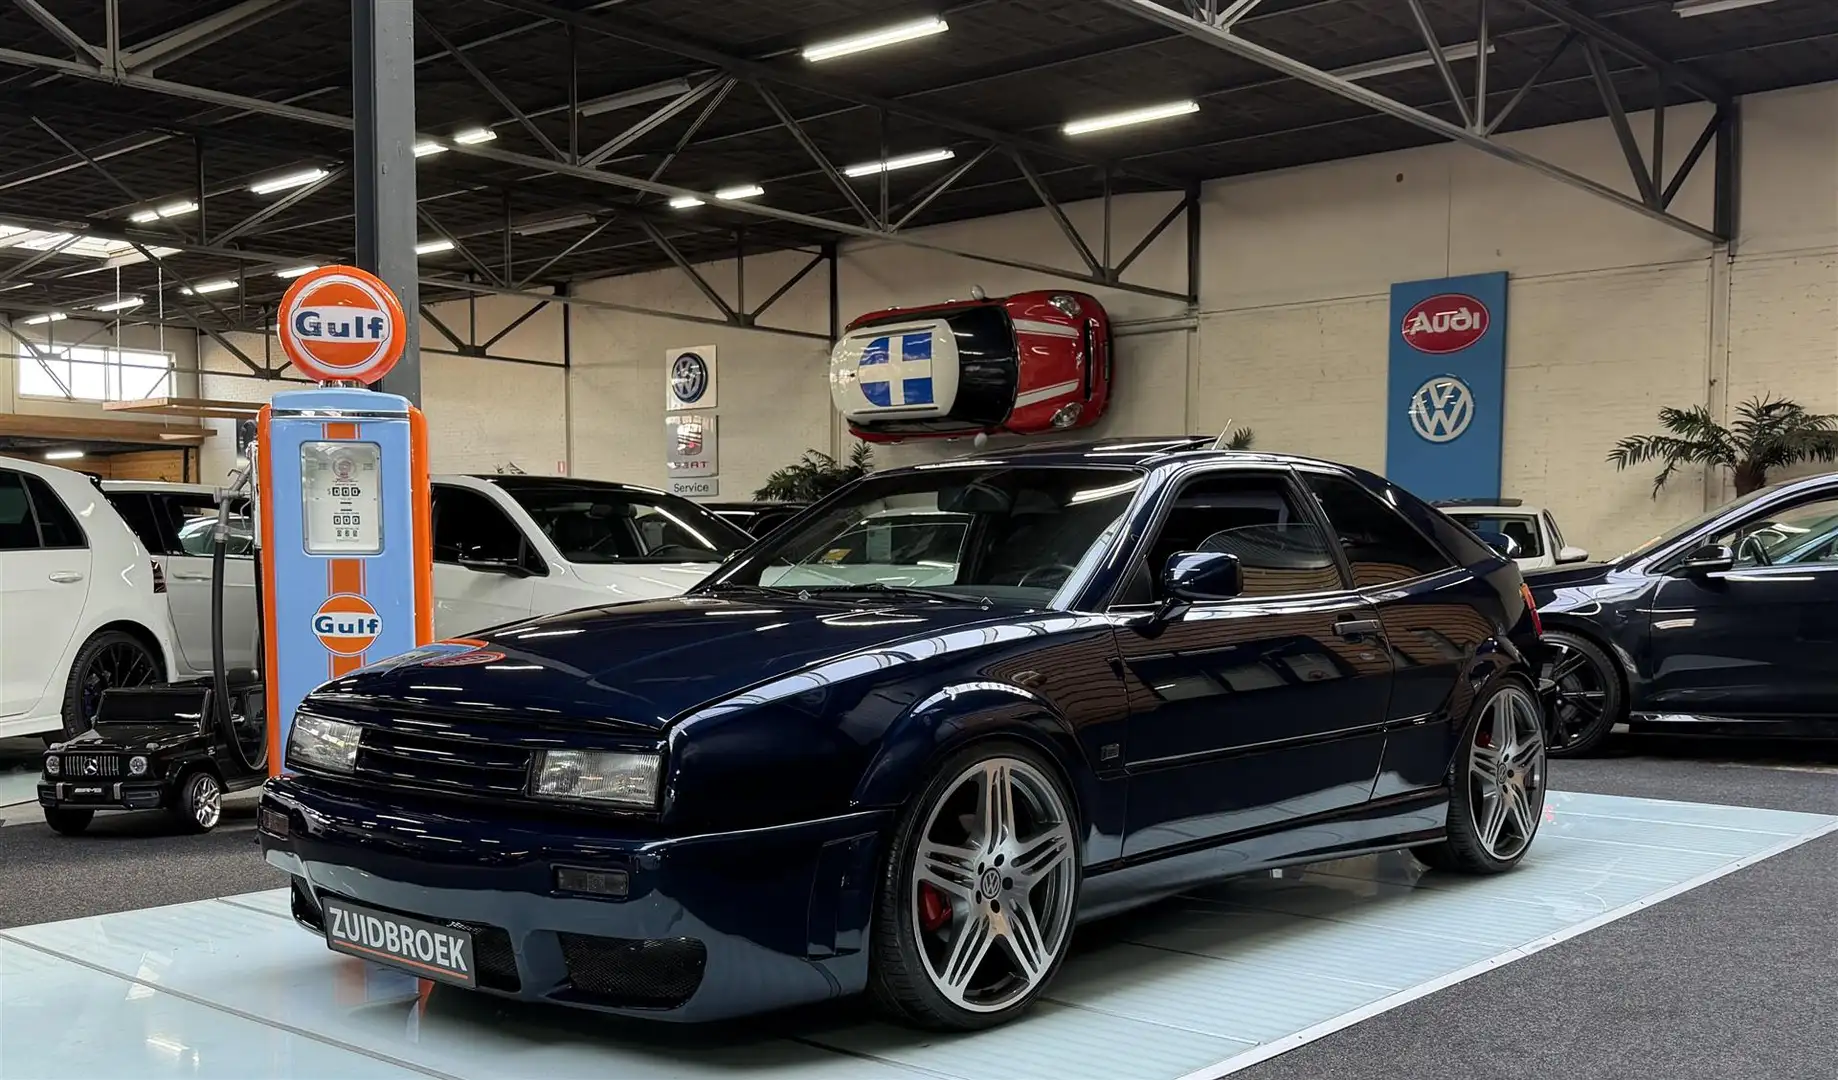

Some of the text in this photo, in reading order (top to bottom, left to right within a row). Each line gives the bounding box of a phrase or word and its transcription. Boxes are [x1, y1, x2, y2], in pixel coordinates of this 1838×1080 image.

[296, 311, 384, 338] Gulf
[673, 483, 709, 493] Service
[315, 616, 378, 634] Gulf
[329, 906, 468, 972] ZUIDBROEK
